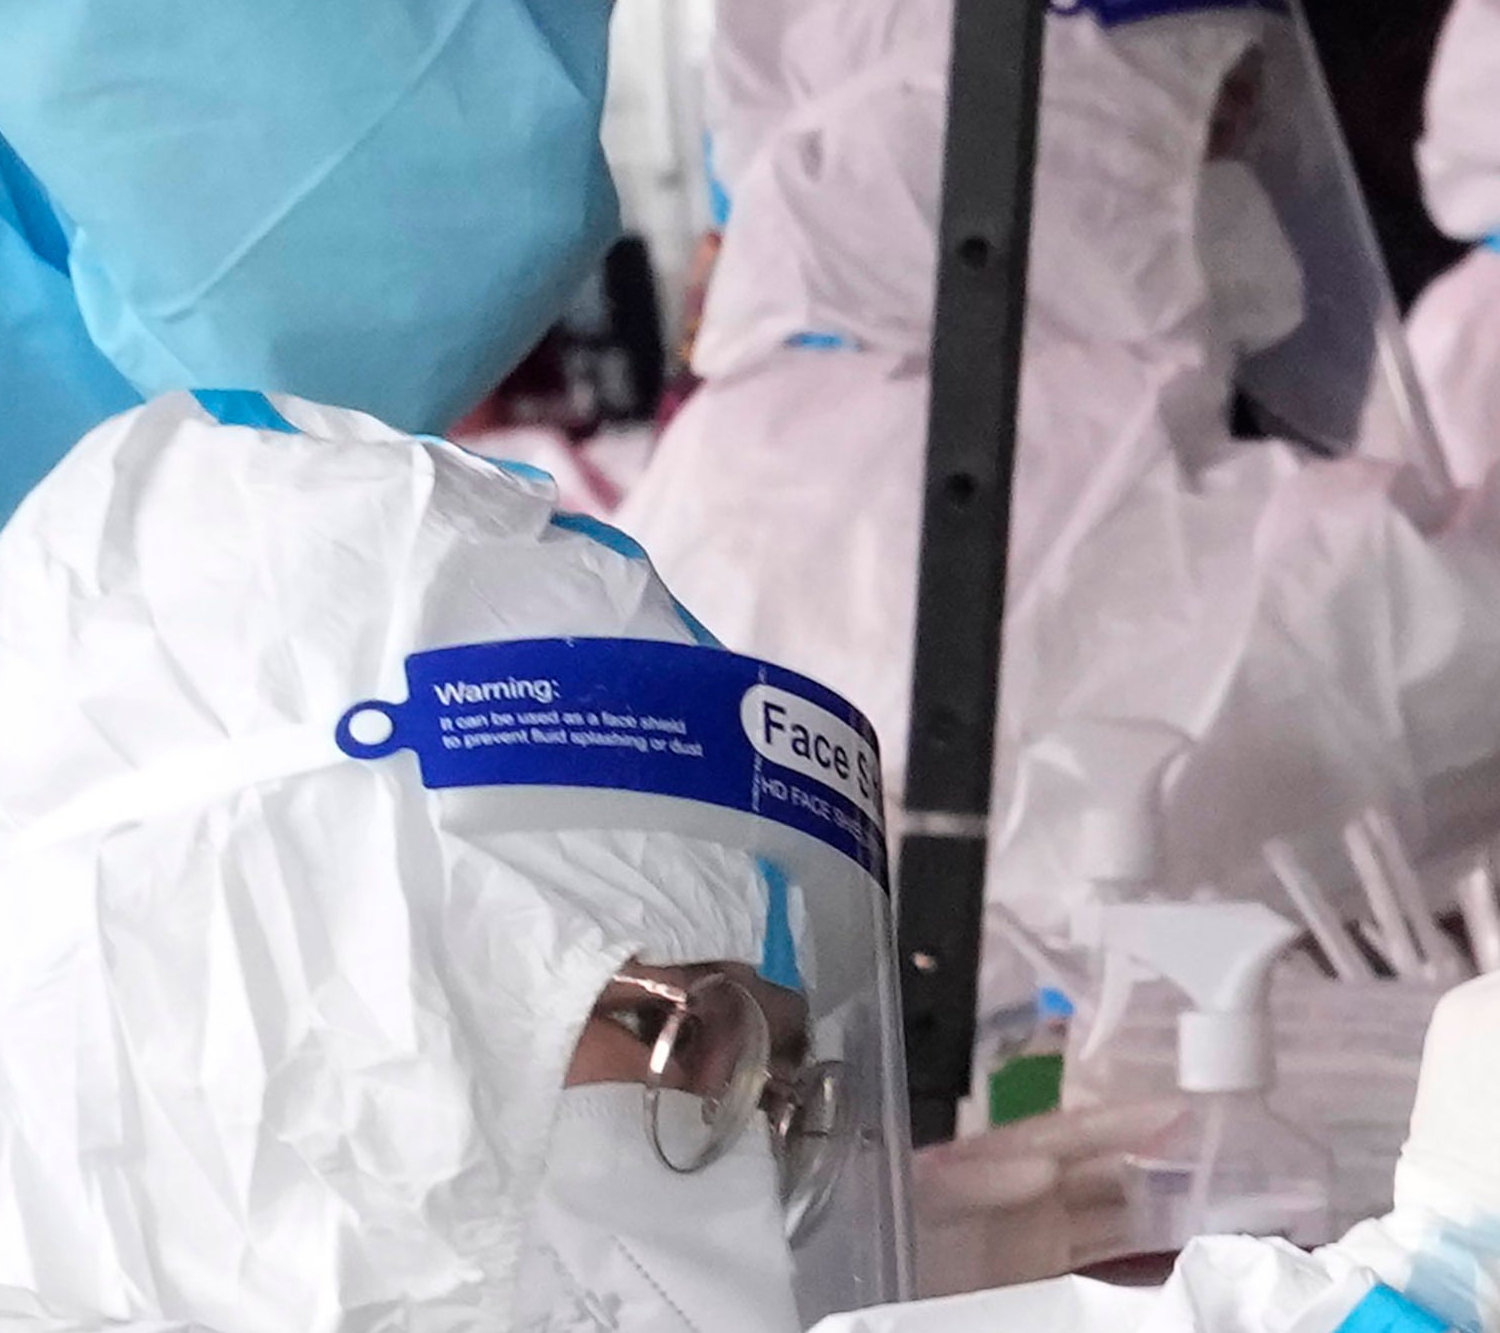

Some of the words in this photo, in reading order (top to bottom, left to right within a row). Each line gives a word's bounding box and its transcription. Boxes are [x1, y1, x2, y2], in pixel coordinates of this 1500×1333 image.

[433, 676, 561, 707] Warning:
[455, 714, 489, 729] can
[490, 711, 515, 726] be
[517, 710, 559, 726] used
[562, 713, 585, 726] as
[587, 714, 599, 726] a
[601, 711, 638, 729] face
[639, 715, 687, 735] shield
[442, 735, 462, 749] to
[464, 730, 530, 749] prevent
[531, 727, 568, 745] fluid
[570, 730, 649, 753] splashing
[649, 738, 667, 752] or
[668, 738, 704, 758] dust
[762, 699, 850, 780] Face
[761, 776, 788, 802] HD
[790, 785, 833, 822] FACE
